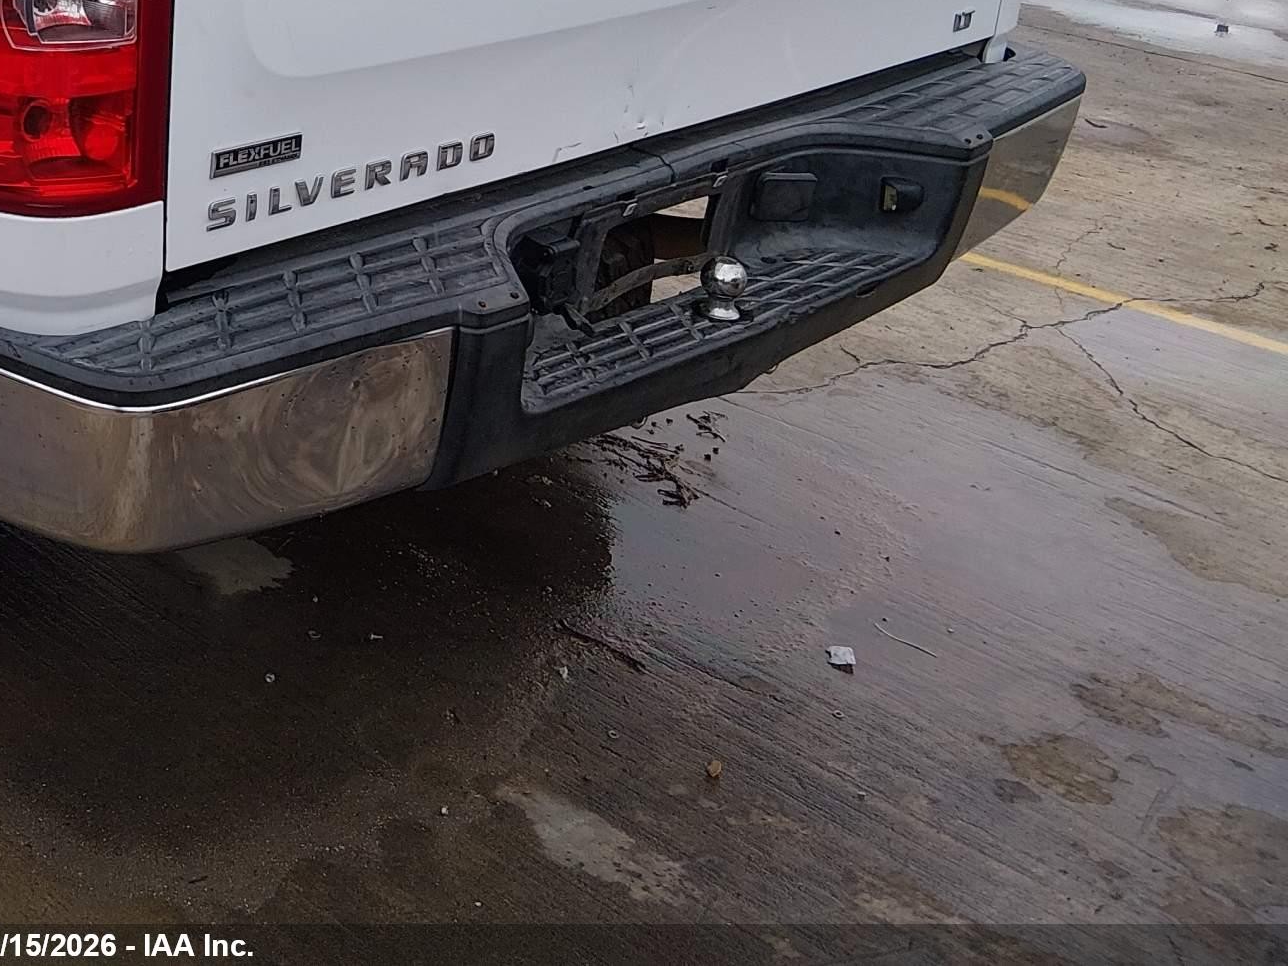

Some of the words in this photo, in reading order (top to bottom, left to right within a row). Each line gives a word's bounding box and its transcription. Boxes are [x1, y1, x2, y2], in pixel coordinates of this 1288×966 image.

[953, 10, 976, 32] LT
[219, 138, 300, 168] FLEXFUEL
[206, 132, 495, 232] SILVERADO
